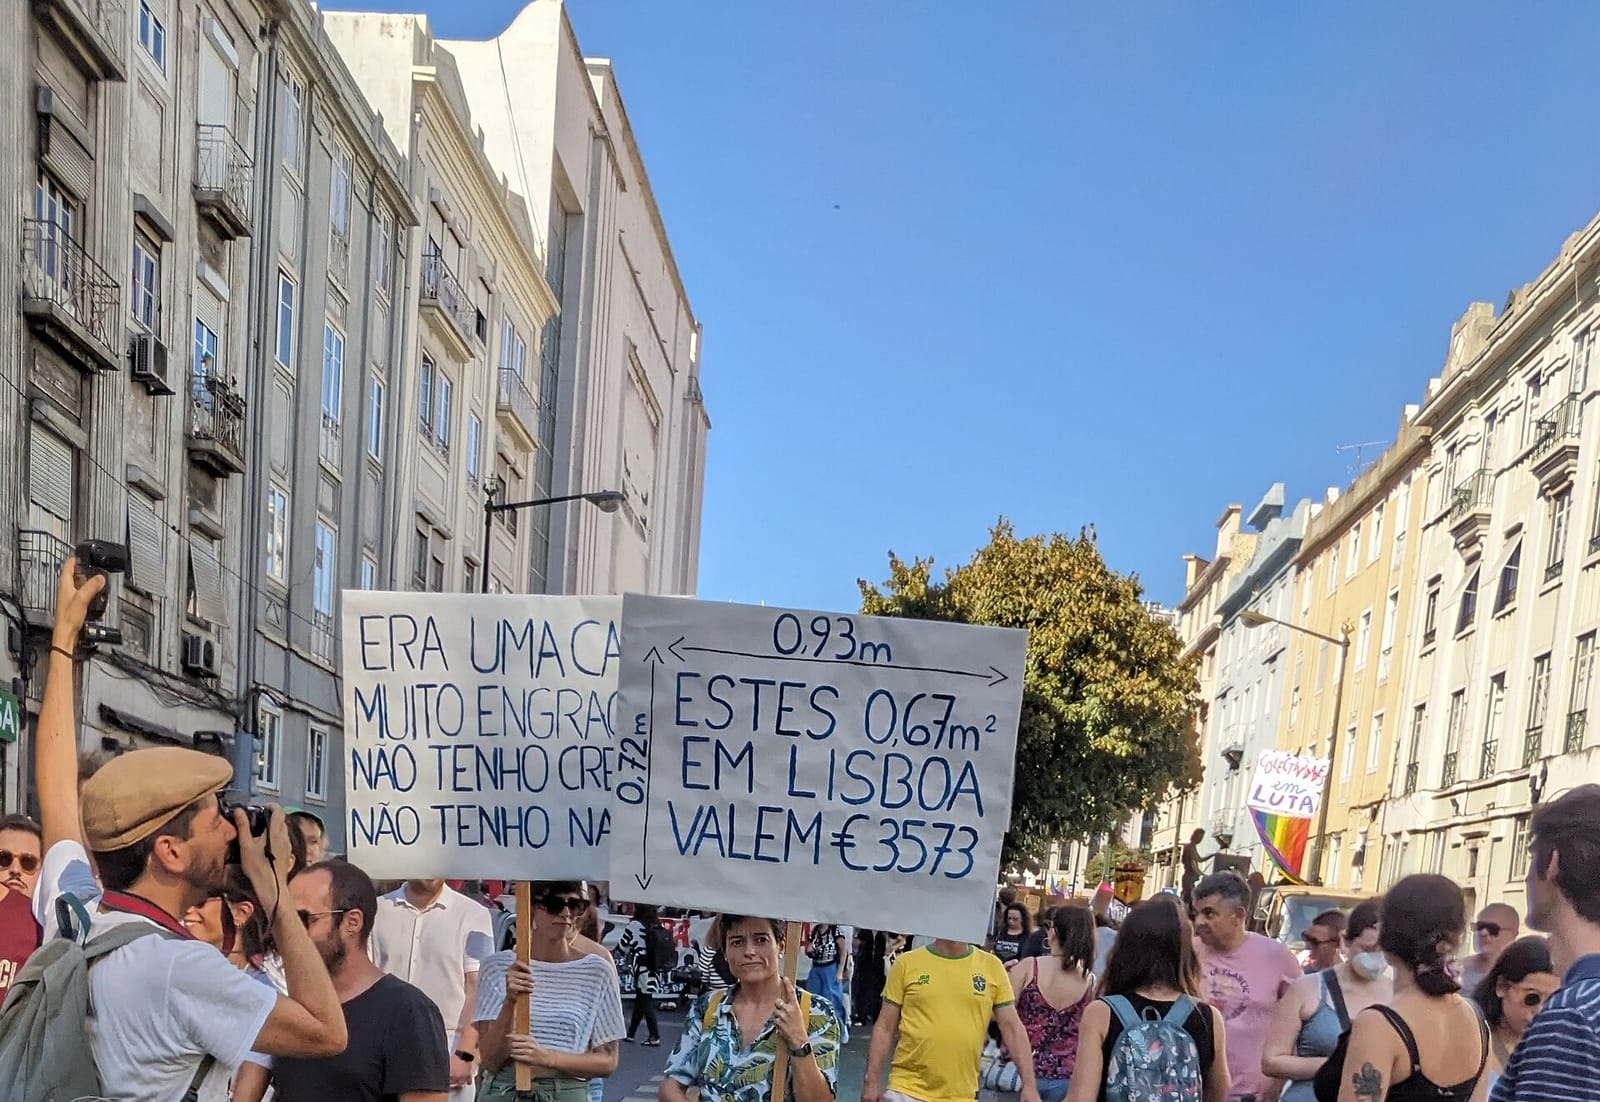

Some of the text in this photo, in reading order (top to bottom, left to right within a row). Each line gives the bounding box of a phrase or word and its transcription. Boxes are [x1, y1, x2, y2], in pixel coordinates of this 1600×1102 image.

[359, 614, 449, 672] ERA
[470, 616, 565, 678] UMA
[773, 612, 892, 663] 0,93m
[353, 683, 465, 740] MUITO
[674, 672, 839, 740] ESTES
[351, 742, 417, 792] NÃO
[428, 744, 549, 793] TENHO
[616, 713, 648, 805] 0,72m
[681, 736, 984, 818] EM LISBOA
[351, 801, 420, 848] NÃO
[430, 804, 550, 849] TENHO
[1252, 784, 1314, 814] LUTA
[667, 800, 980, 879] VALEM €3573
